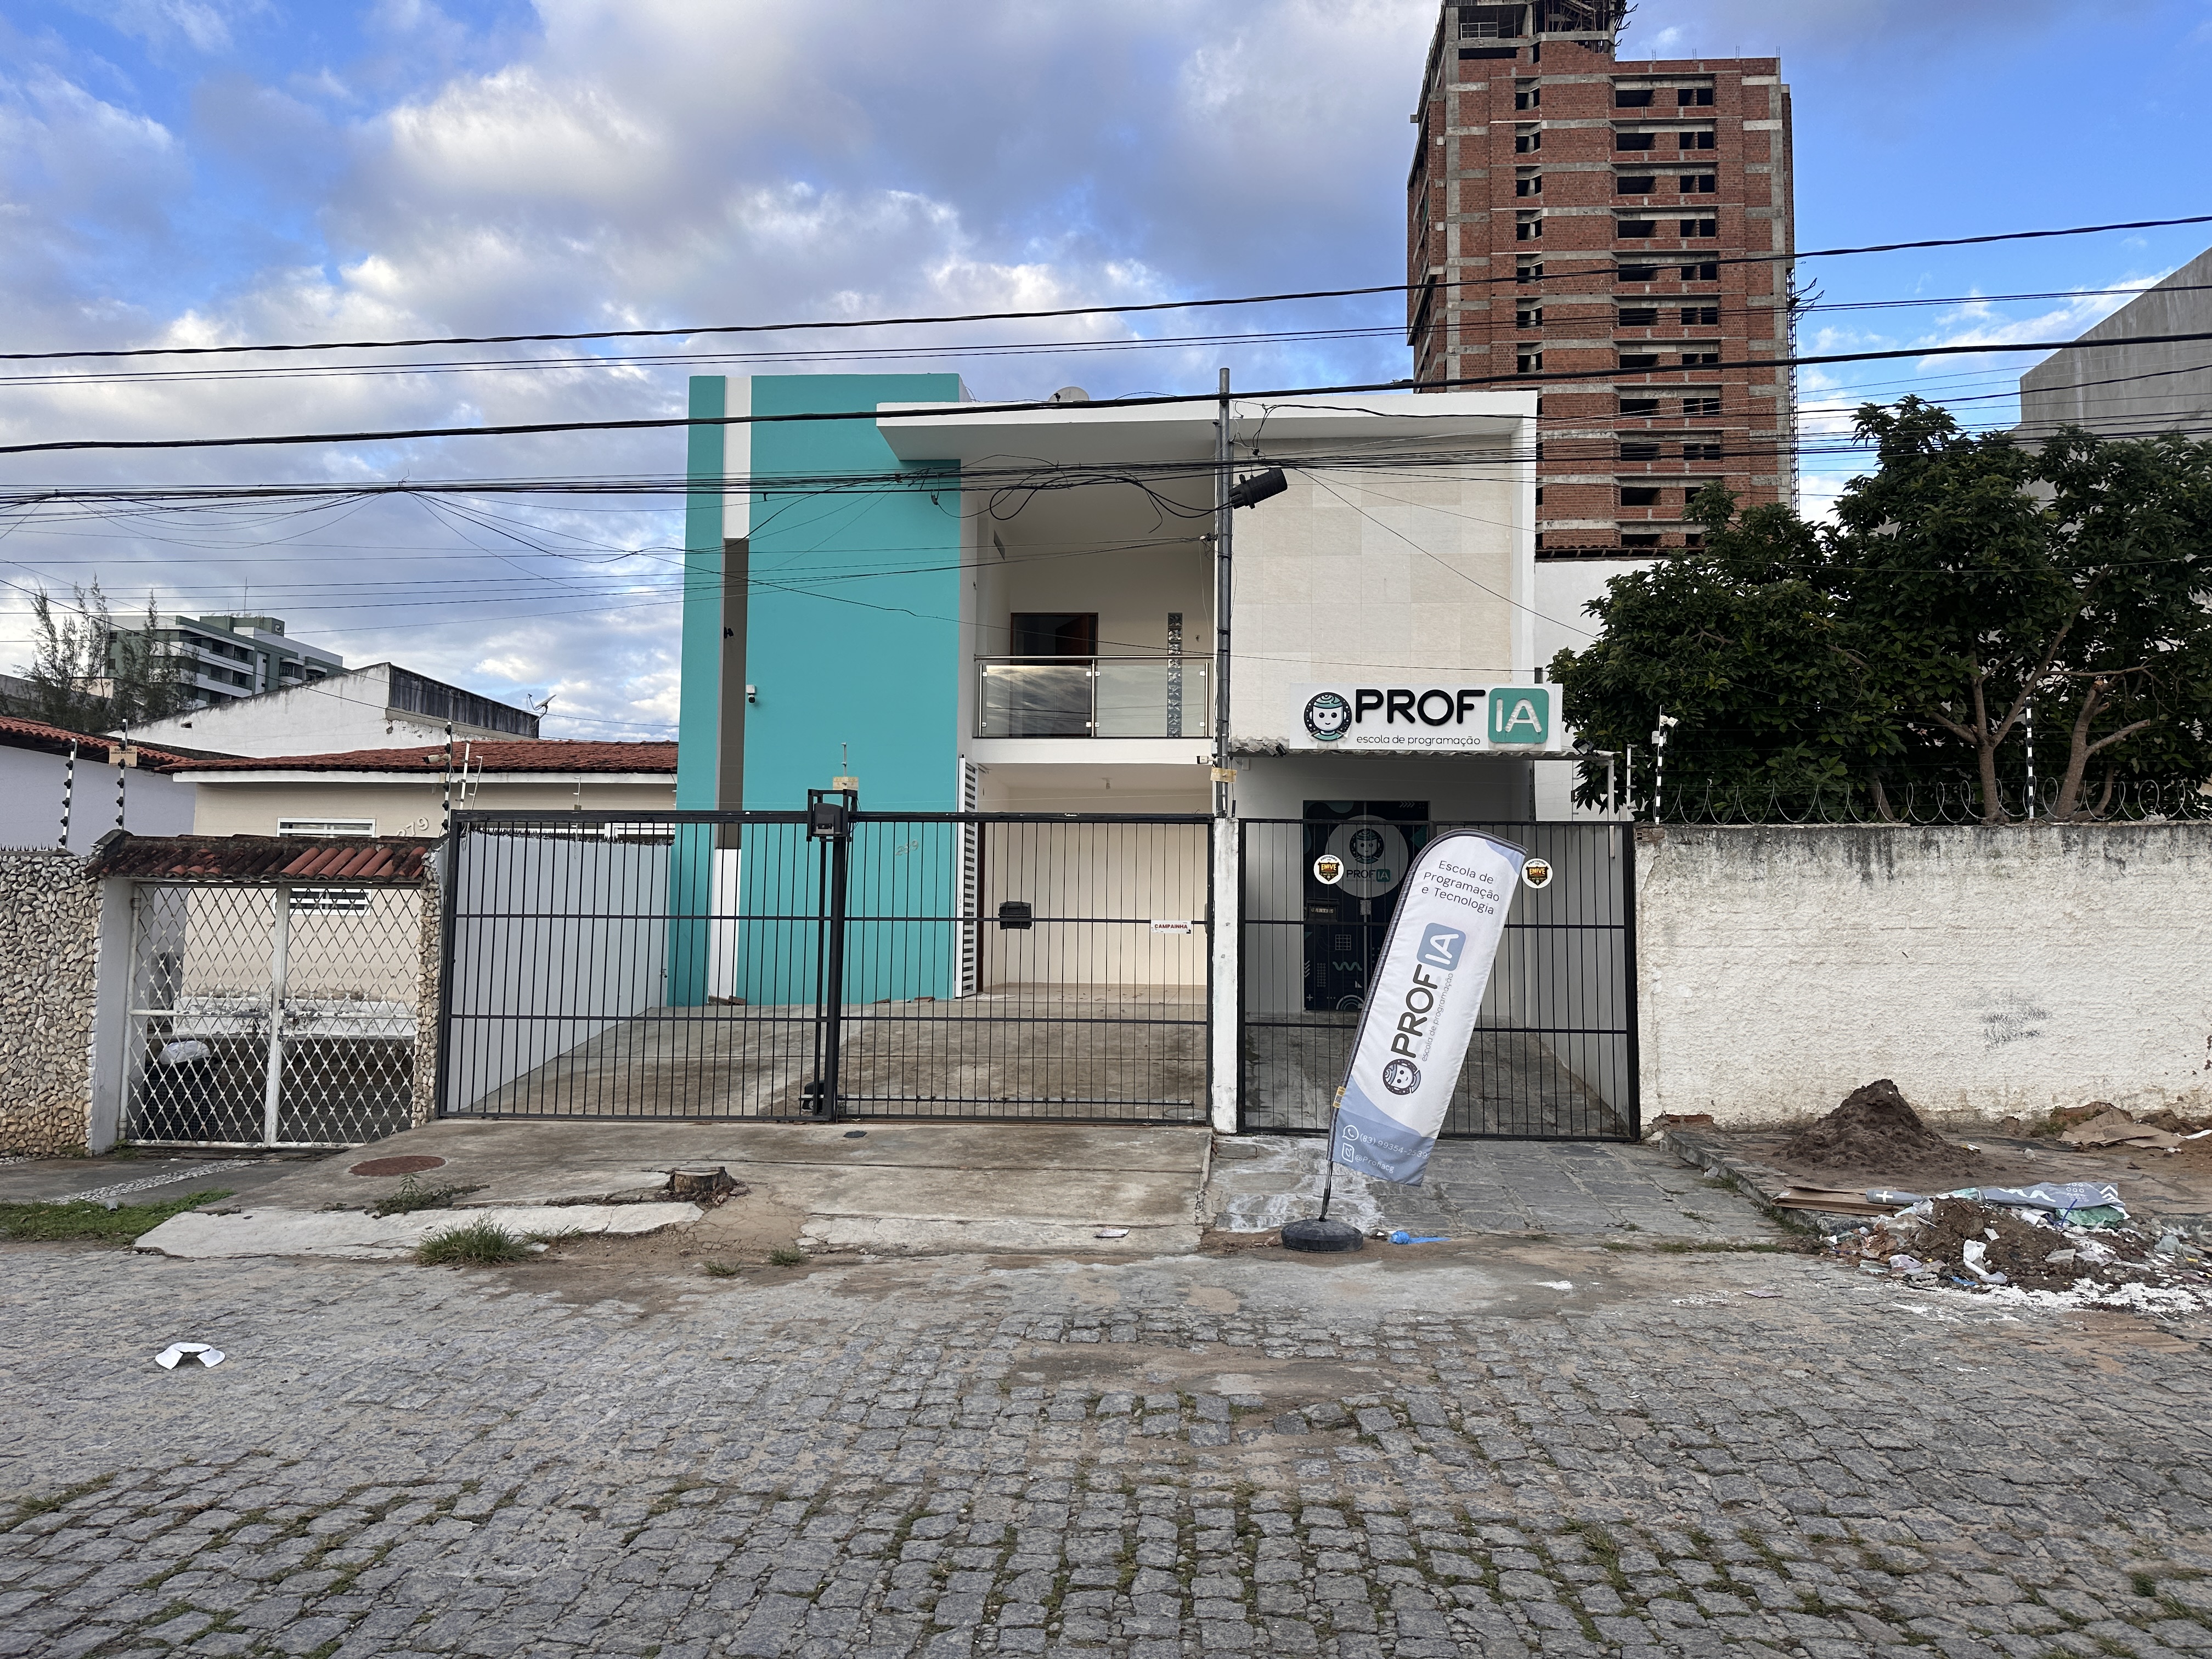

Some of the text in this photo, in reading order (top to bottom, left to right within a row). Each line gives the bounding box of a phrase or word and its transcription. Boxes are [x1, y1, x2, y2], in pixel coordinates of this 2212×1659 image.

[1355, 689, 1542, 733] PROF IA
[1357, 735, 1481, 747] escola de programação
[1346, 870, 1389, 879] PROF IA
[1438, 860, 1494, 884] Escola de
[1423, 872, 1499, 901] Programação
[1435, 887, 1494, 915] Tecnologia
[1390, 933, 1459, 1058] PROF IA
[1421, 973, 1453, 1062] escola de programação
[1359, 1133, 1427, 1159] (83) 99354-2539
